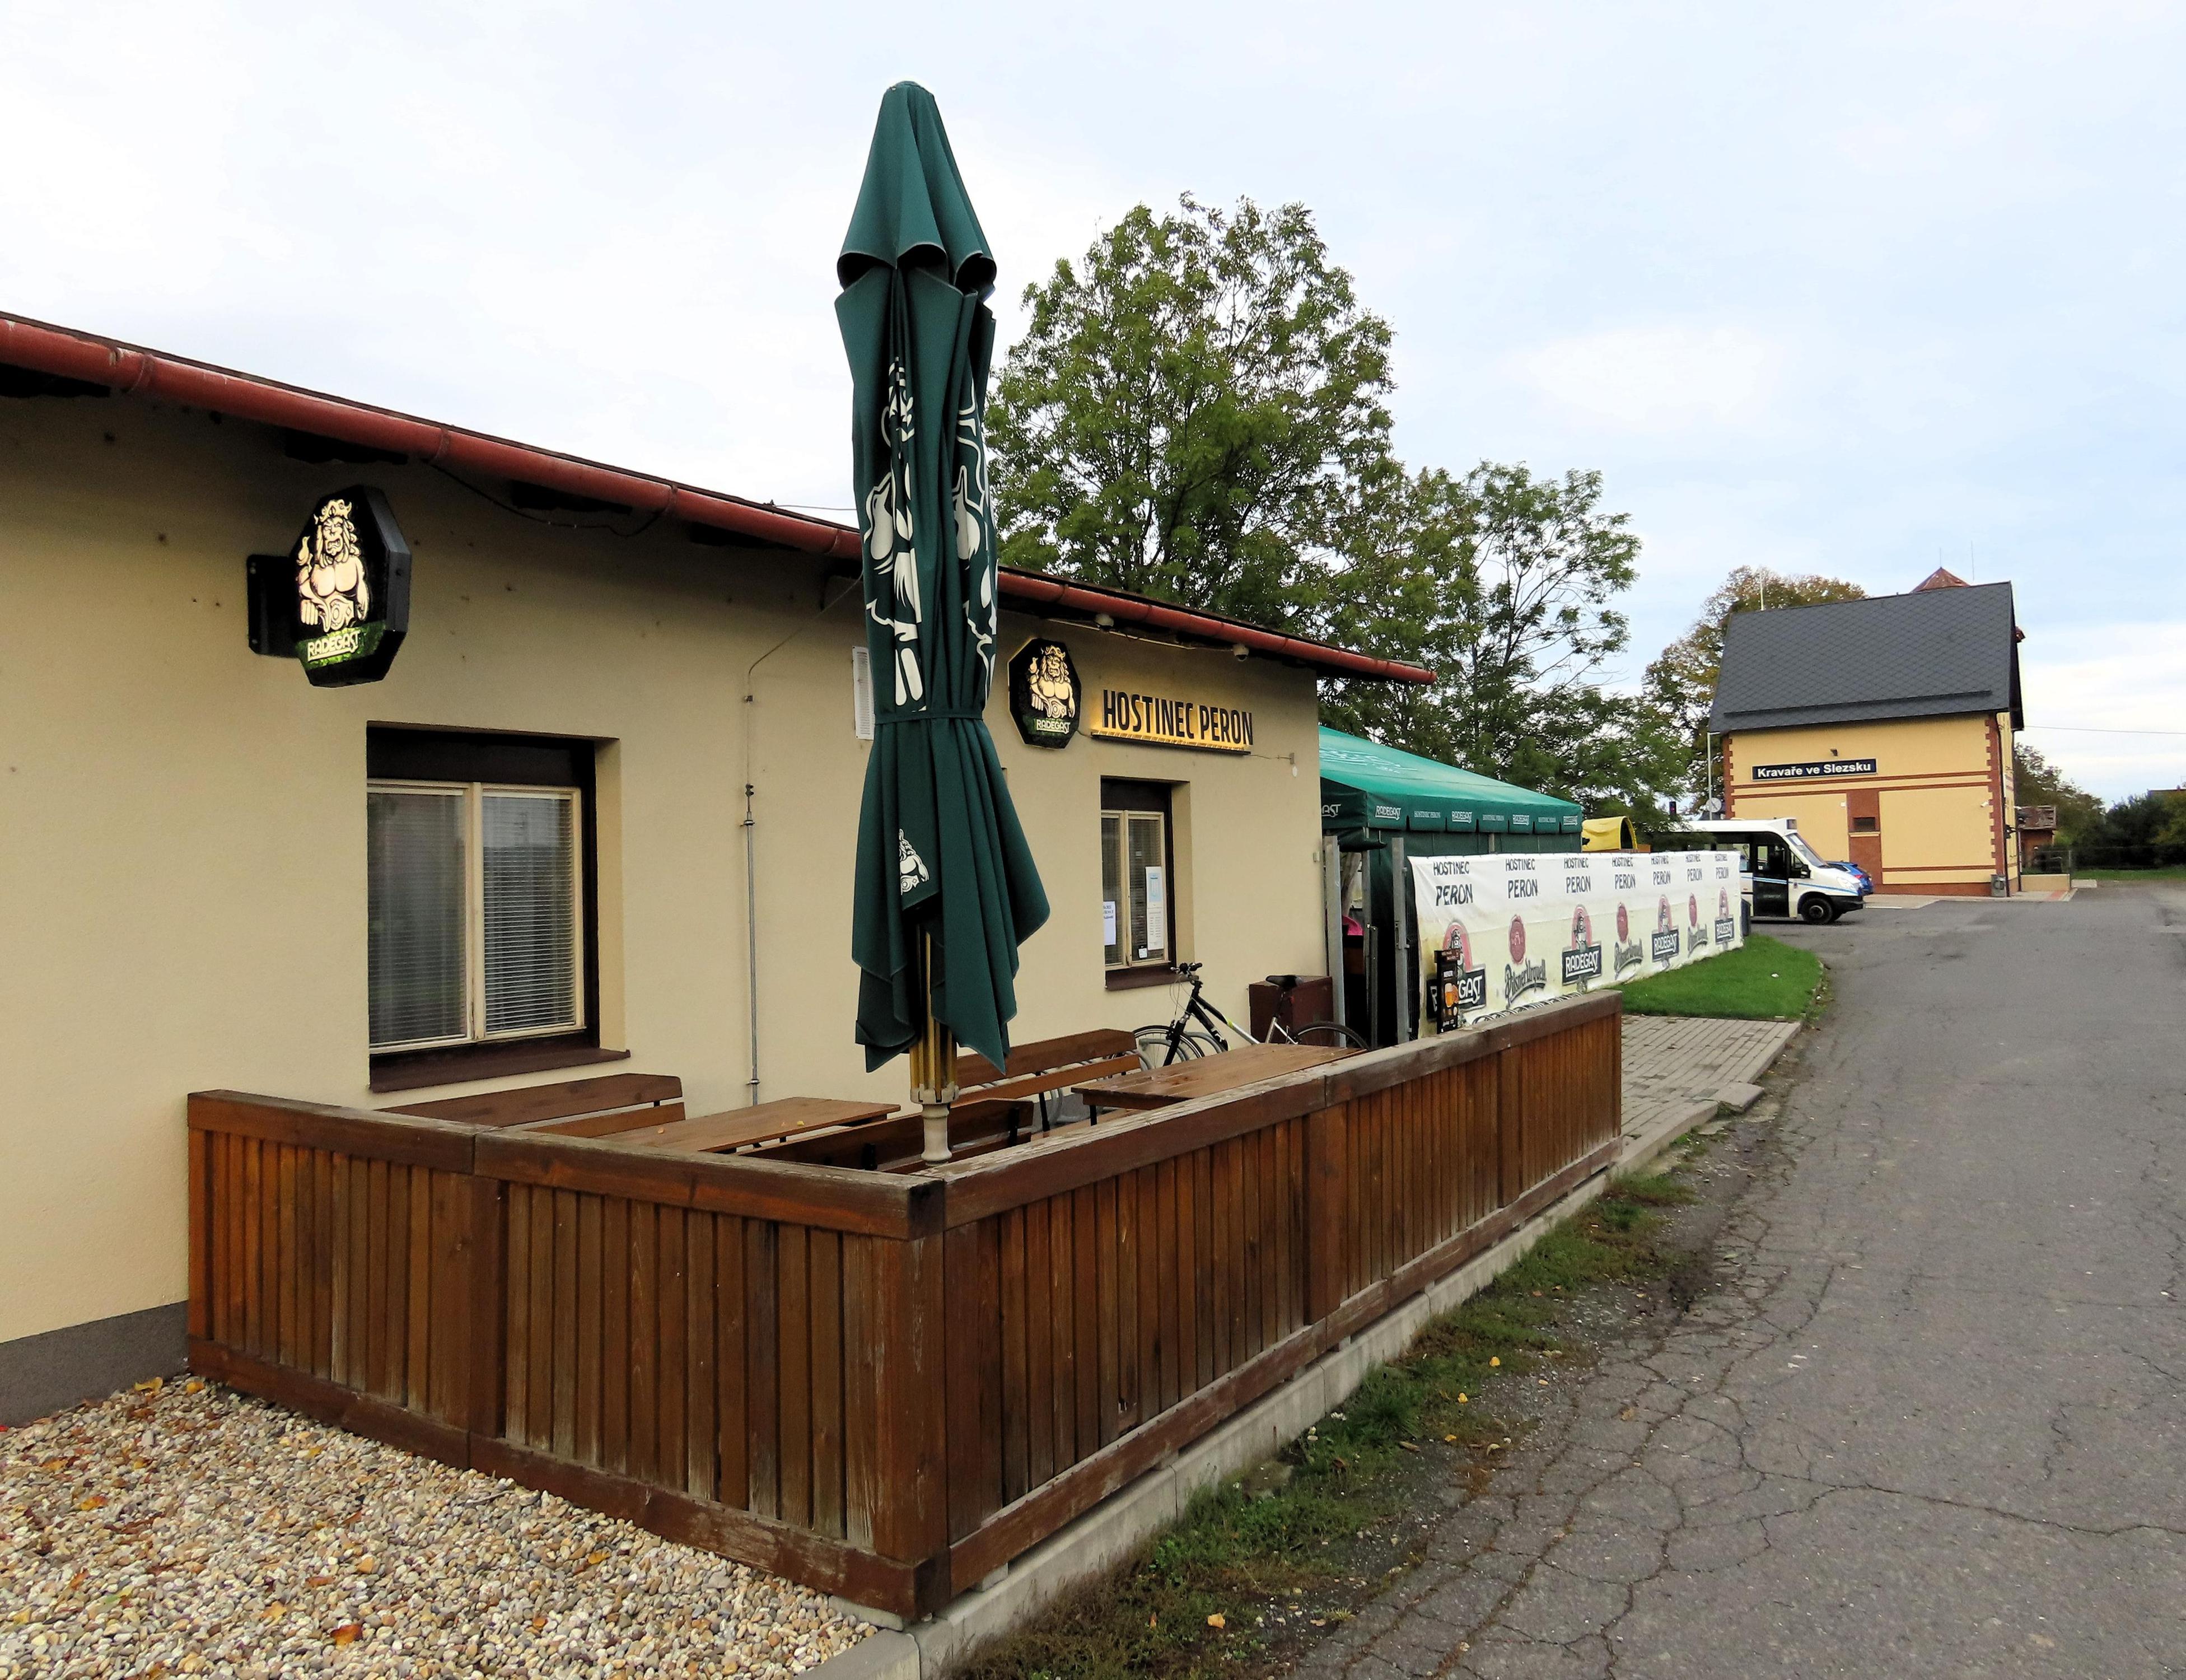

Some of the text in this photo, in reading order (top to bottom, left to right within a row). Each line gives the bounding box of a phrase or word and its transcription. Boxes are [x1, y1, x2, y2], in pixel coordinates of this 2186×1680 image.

[308, 630, 361, 662] RADEGAST
[1103, 689, 1254, 745] HOSTINEC PERON
[1036, 719, 1071, 734] RADEGAST
[1758, 766, 1802, 777] Kravaře
[1823, 762, 1871, 774] Slezsku
[1375, 805, 1401, 820] RADEGAST
[1433, 861, 1469, 875] HOSTINEC
[1506, 858, 1535, 871] HOSTINEC
[1564, 857, 1589, 868] HOSTINEC
[1612, 857, 1633, 867] HOSTINEC
[1615, 874, 1636, 889] PERON
[1653, 871, 1671, 885] PERON
[1687, 869, 1702, 882] PERON
[1508, 879, 1538, 898] PERON
[1566, 876, 1591, 893] PERON
[1436, 884, 1473, 906] PERON
[1653, 934, 1677, 955] RADEGAST
[1565, 950, 1599, 978] RADEGAST
